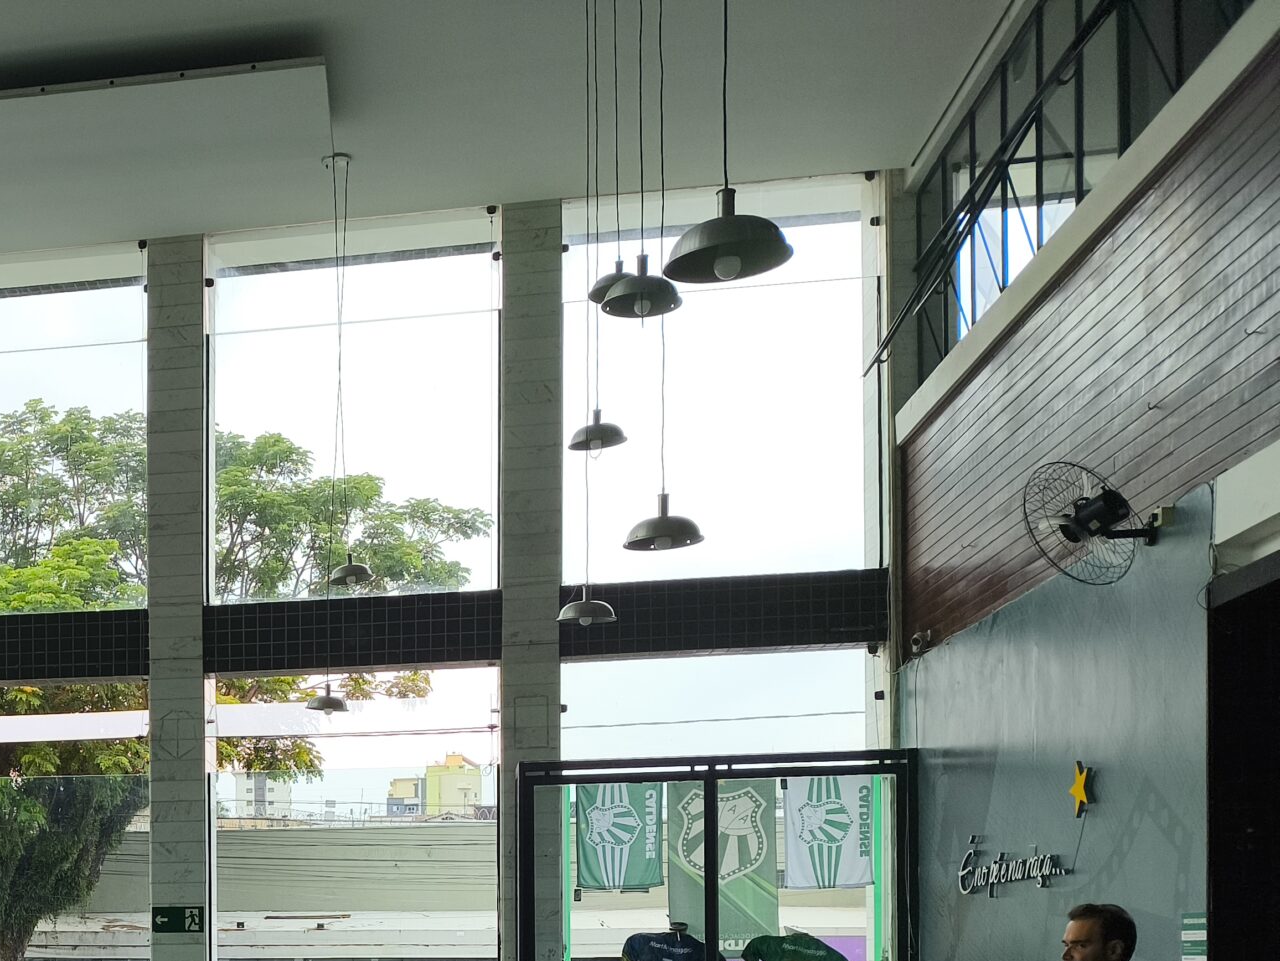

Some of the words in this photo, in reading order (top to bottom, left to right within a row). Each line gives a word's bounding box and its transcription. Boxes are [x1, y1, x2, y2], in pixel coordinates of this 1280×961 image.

[974, 865, 988, 887] no
[1000, 862, 1008, 883] e
[1007, 858, 1025, 881] na
